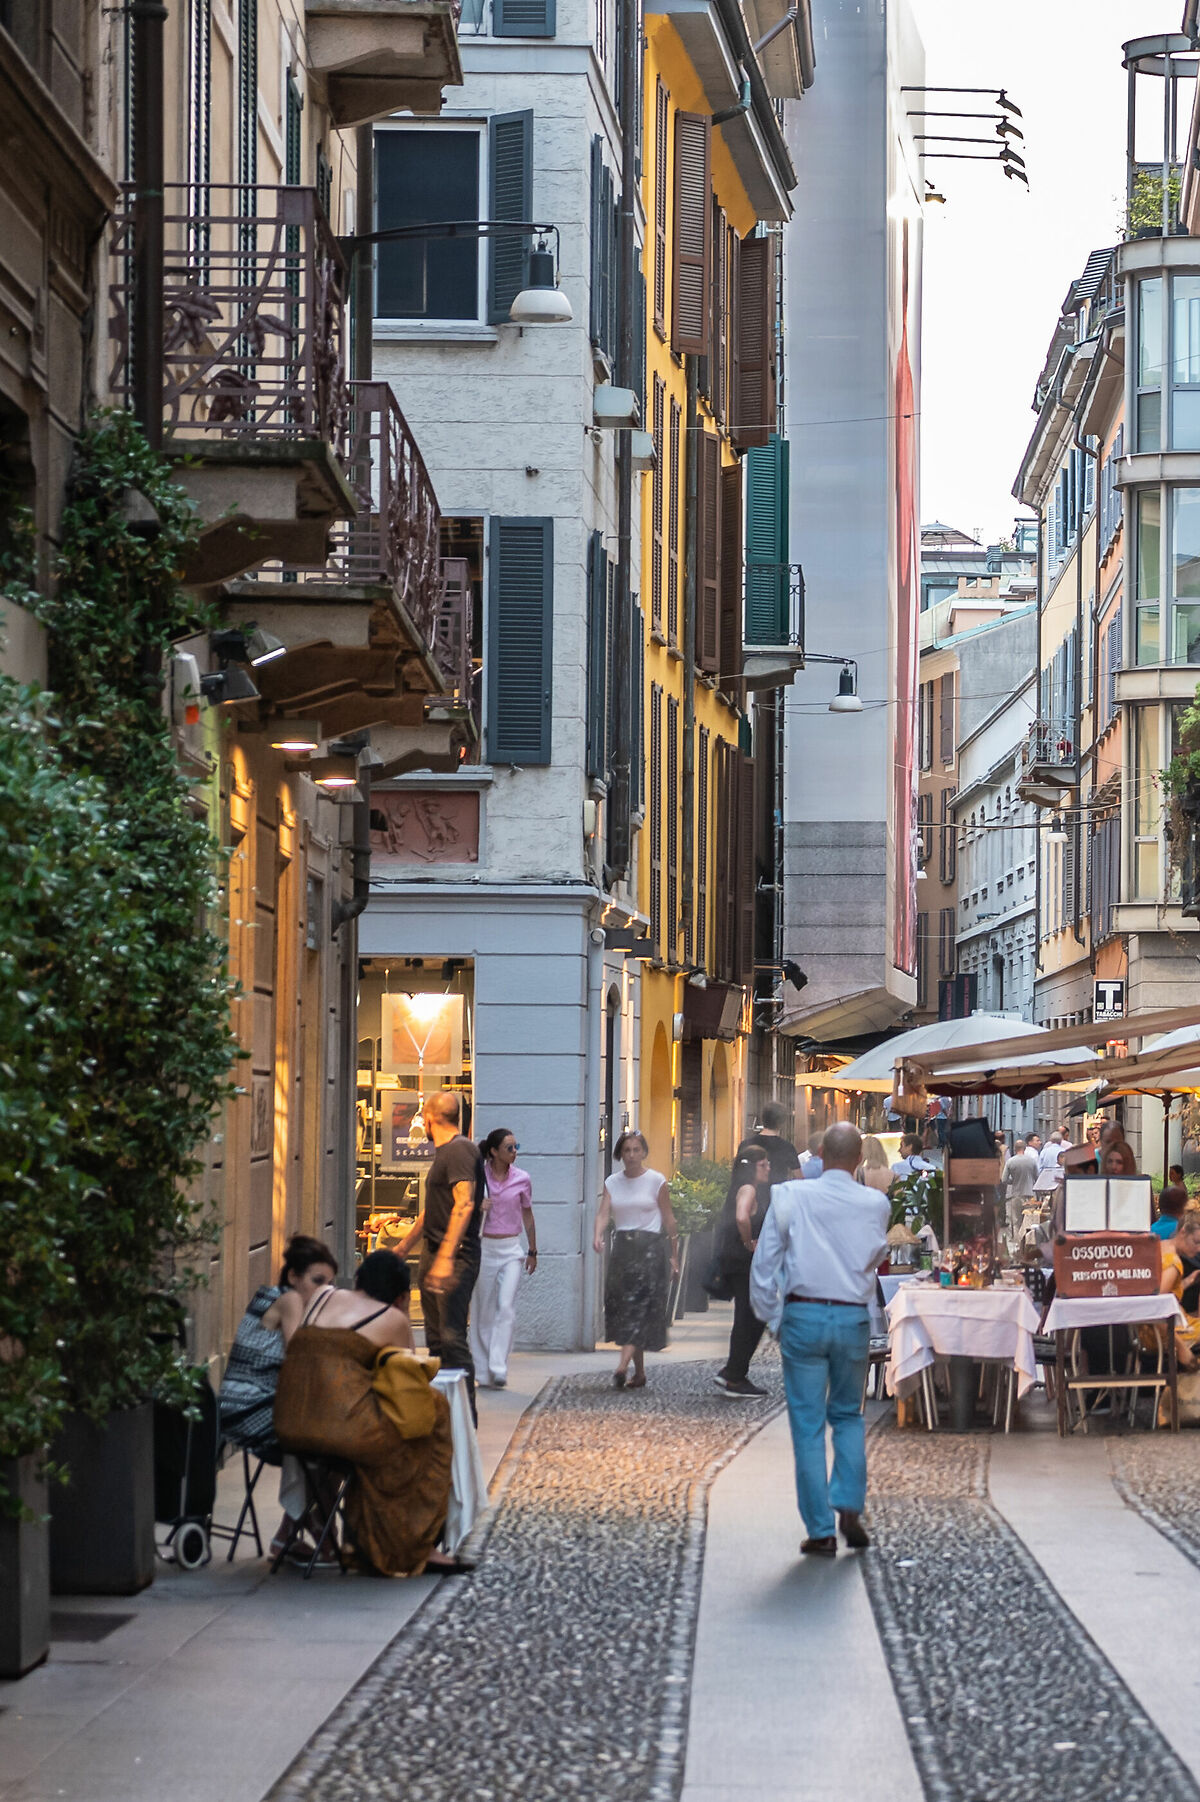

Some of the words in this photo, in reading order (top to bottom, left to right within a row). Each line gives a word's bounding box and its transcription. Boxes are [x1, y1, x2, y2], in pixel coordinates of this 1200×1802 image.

[1099, 983, 1120, 1009] T
[1072, 1245, 1133, 1260] OSSOBUCO
[1072, 1269, 1115, 1281] RISOTTO
[1116, 1268, 1151, 1279] MILANO
